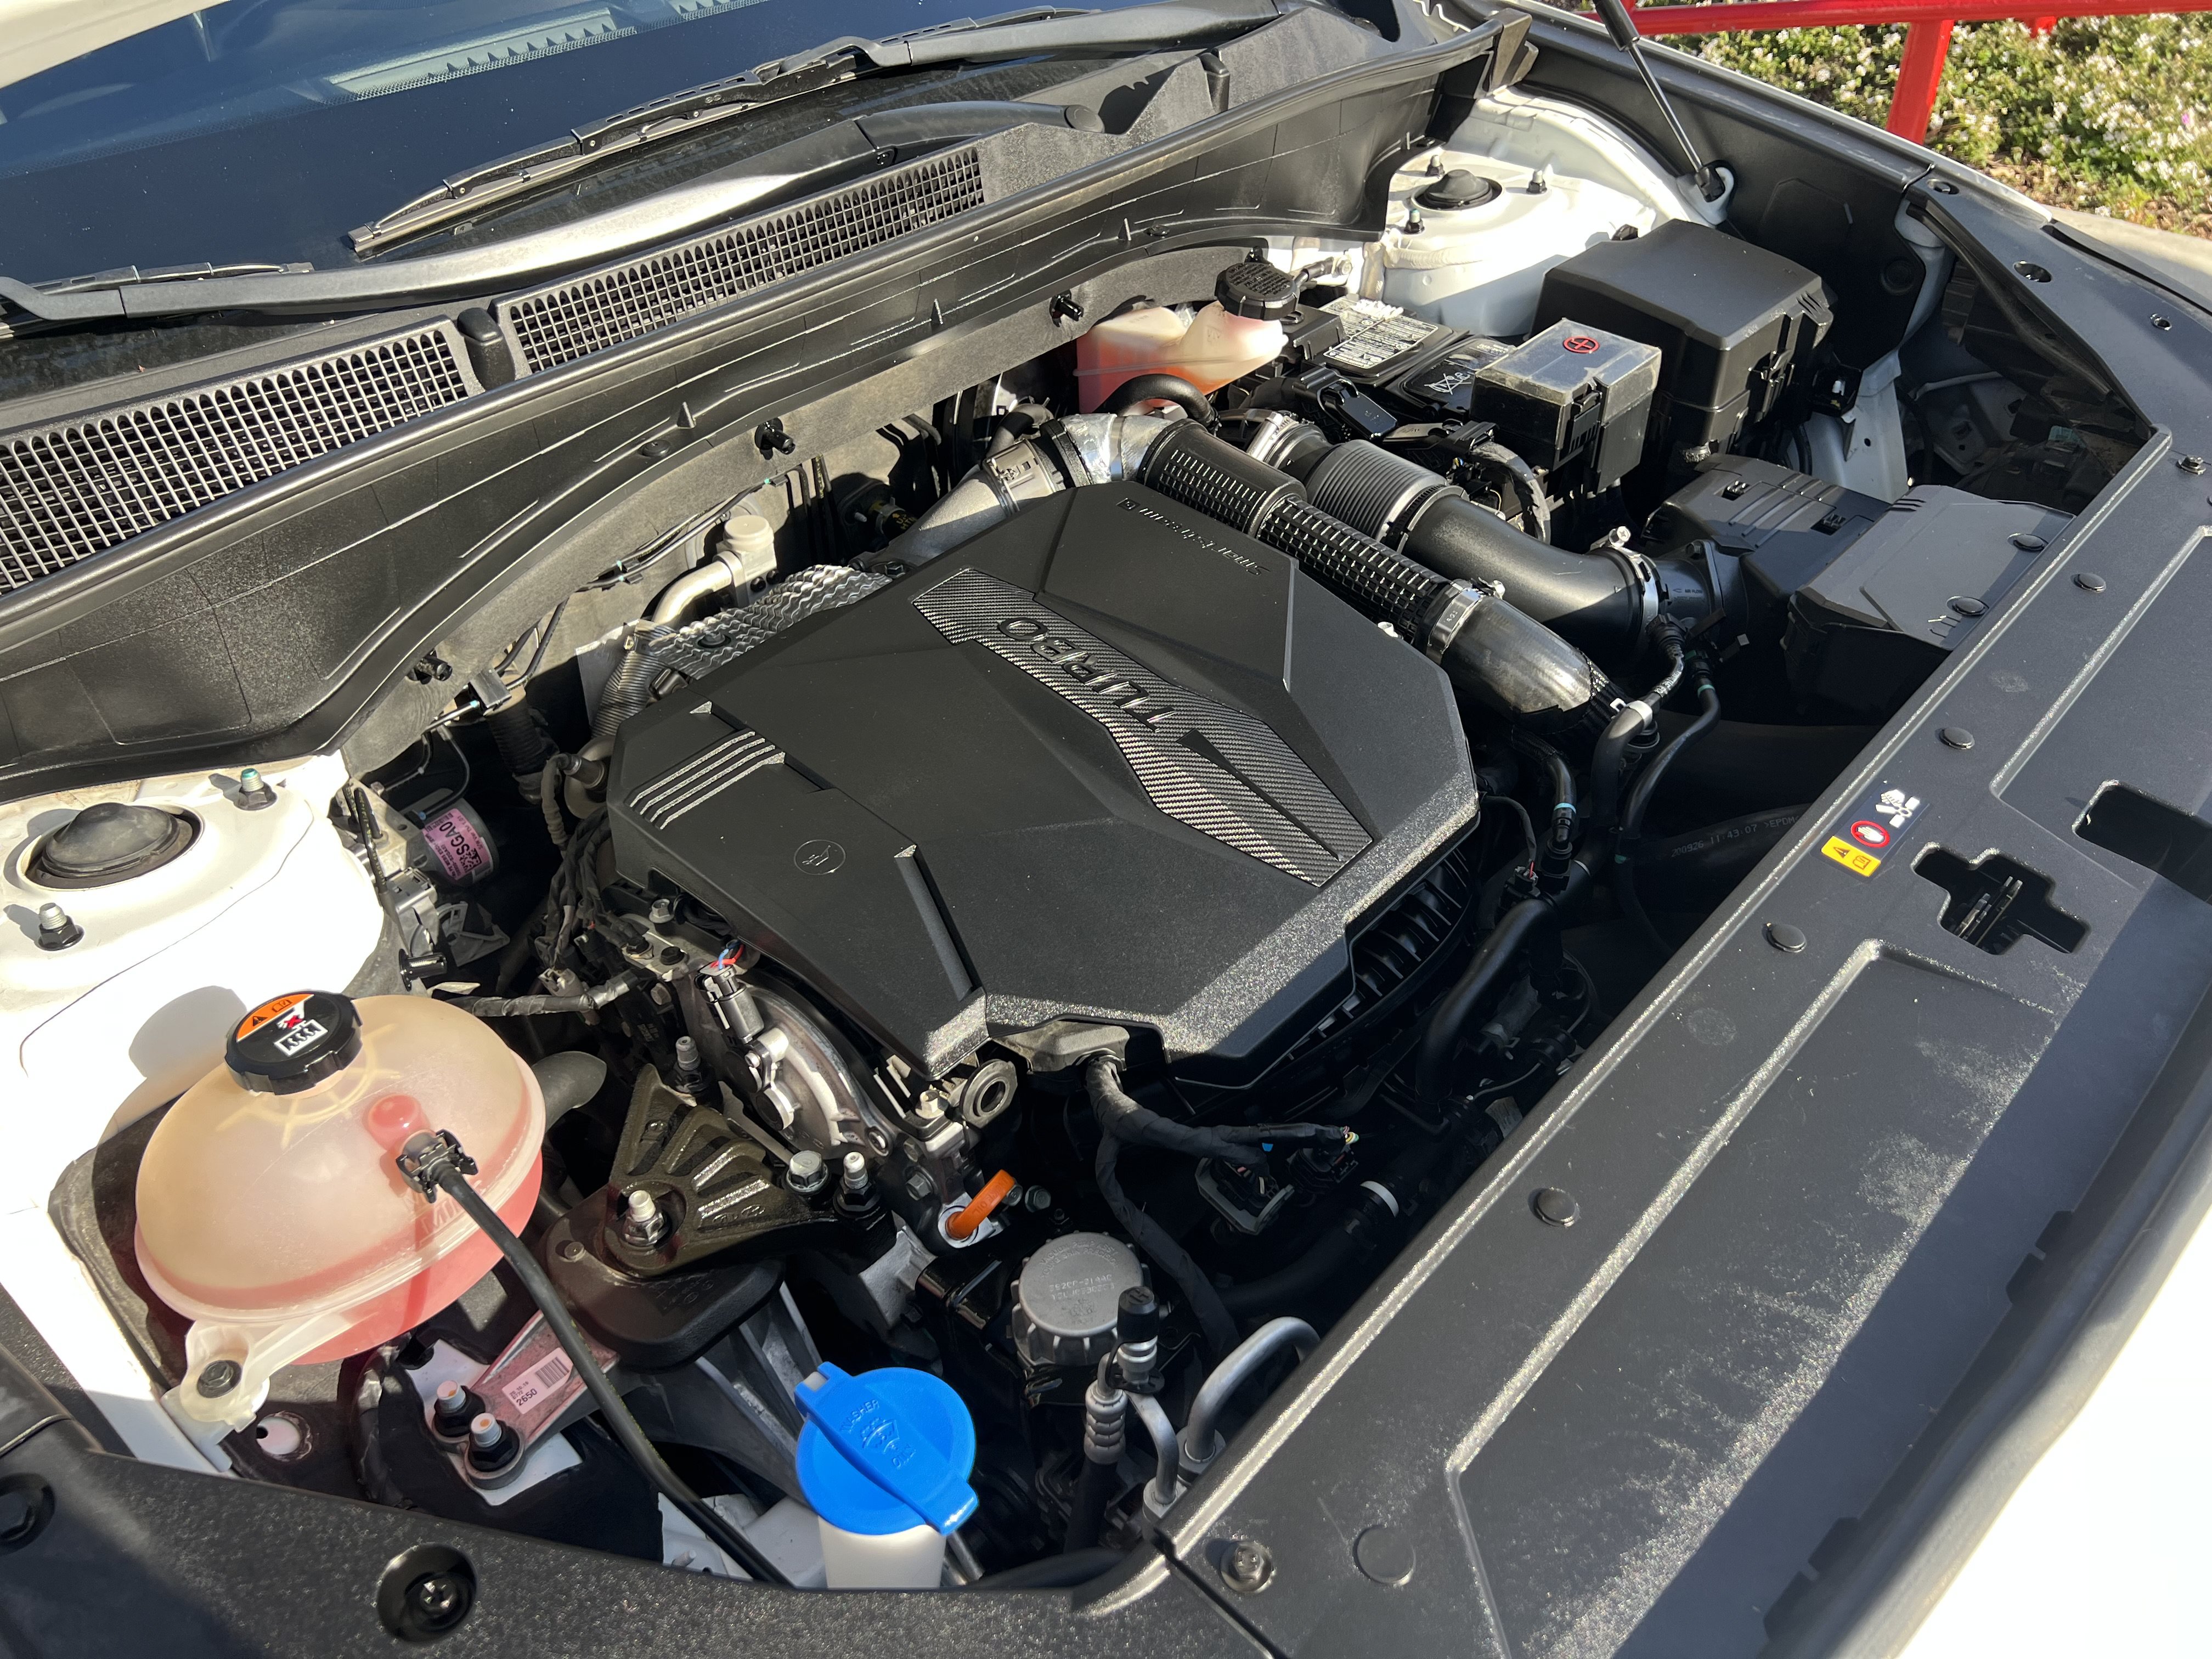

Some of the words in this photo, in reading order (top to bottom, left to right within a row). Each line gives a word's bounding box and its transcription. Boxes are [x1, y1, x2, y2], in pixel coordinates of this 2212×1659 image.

[997, 617, 1175, 733] TURBO
[439, 821, 470, 856] SGA0
[1709, 824, 1757, 845] 11:43:07
[516, 1388, 538, 1406] 2650
